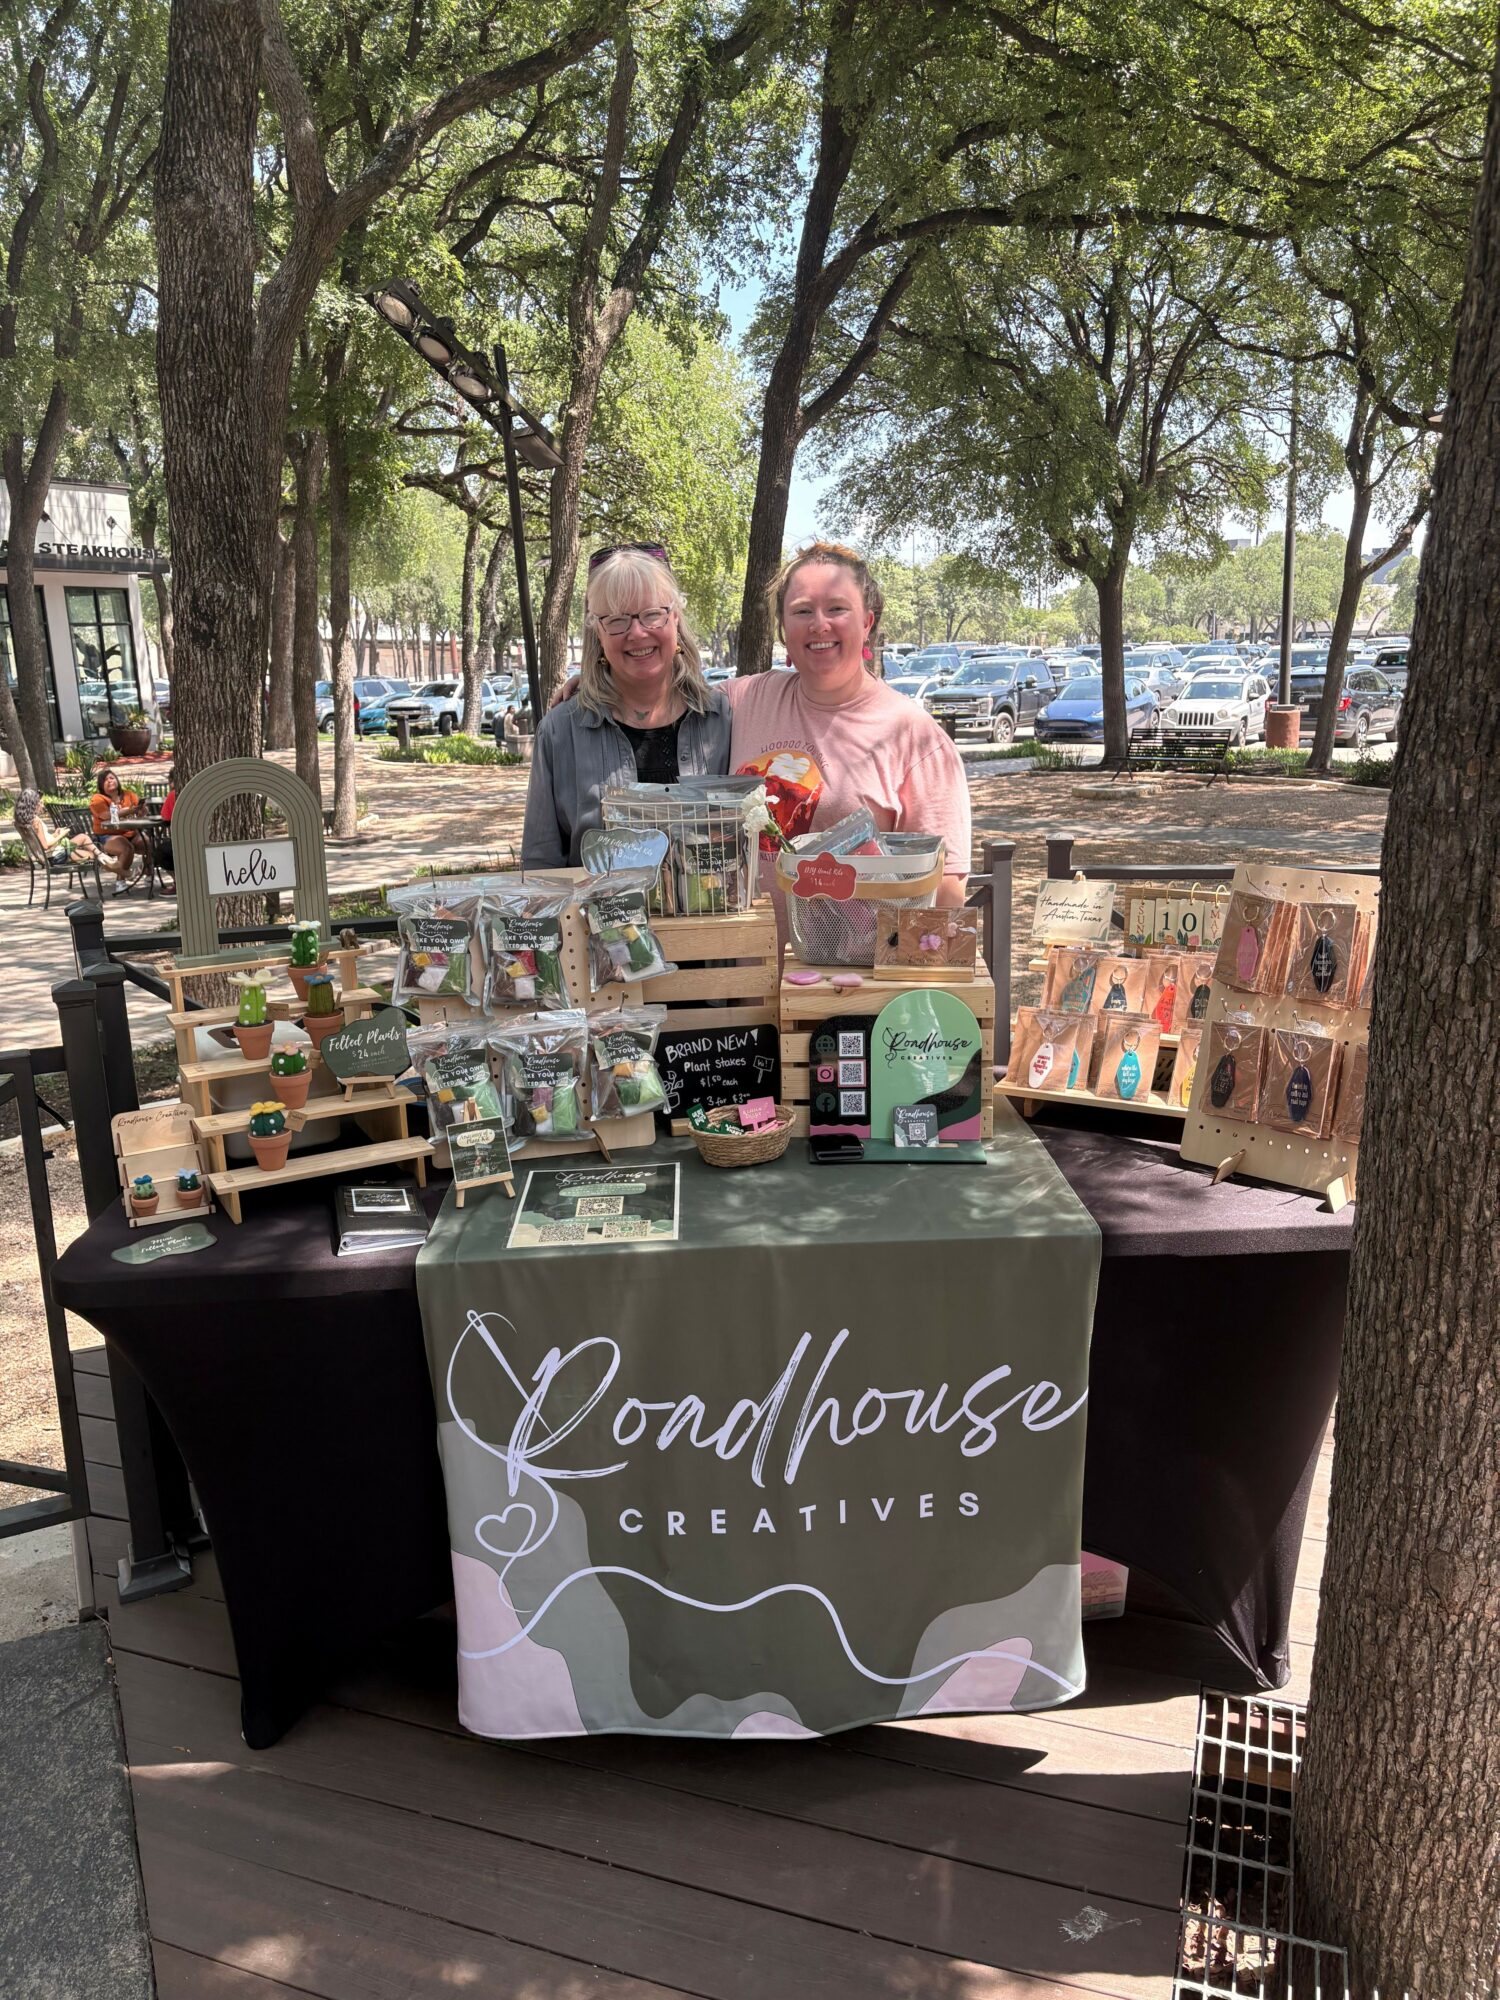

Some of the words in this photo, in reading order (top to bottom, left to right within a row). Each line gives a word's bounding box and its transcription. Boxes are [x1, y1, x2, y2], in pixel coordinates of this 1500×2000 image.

[38, 542, 164, 559] STEAKHOUSE
[222, 848, 277, 886] hello
[1040, 896, 1090, 907] Handmade
[1080, 911, 1103, 922] Texas
[1136, 906, 1145, 934] SUN
[1211, 910, 1220, 938] MAY
[329, 1033, 363, 1052] Felted
[366, 1026, 401, 1044] Plants
[665, 1037, 712, 1063] BRAND
[716, 1028, 759, 1052] NEW!
[887, 1030, 972, 1053] Roadhouse
[451, 1068, 469, 1076] YOUR
[684, 1059, 711, 1072] Plant
[722, 1078, 738, 1086] each
[706, 1095, 714, 1106] 3
[715, 1096, 727, 1106] for
[500, 1326, 1090, 1498] Roadhouse
[618, 1491, 981, 1536] CREATIVES
